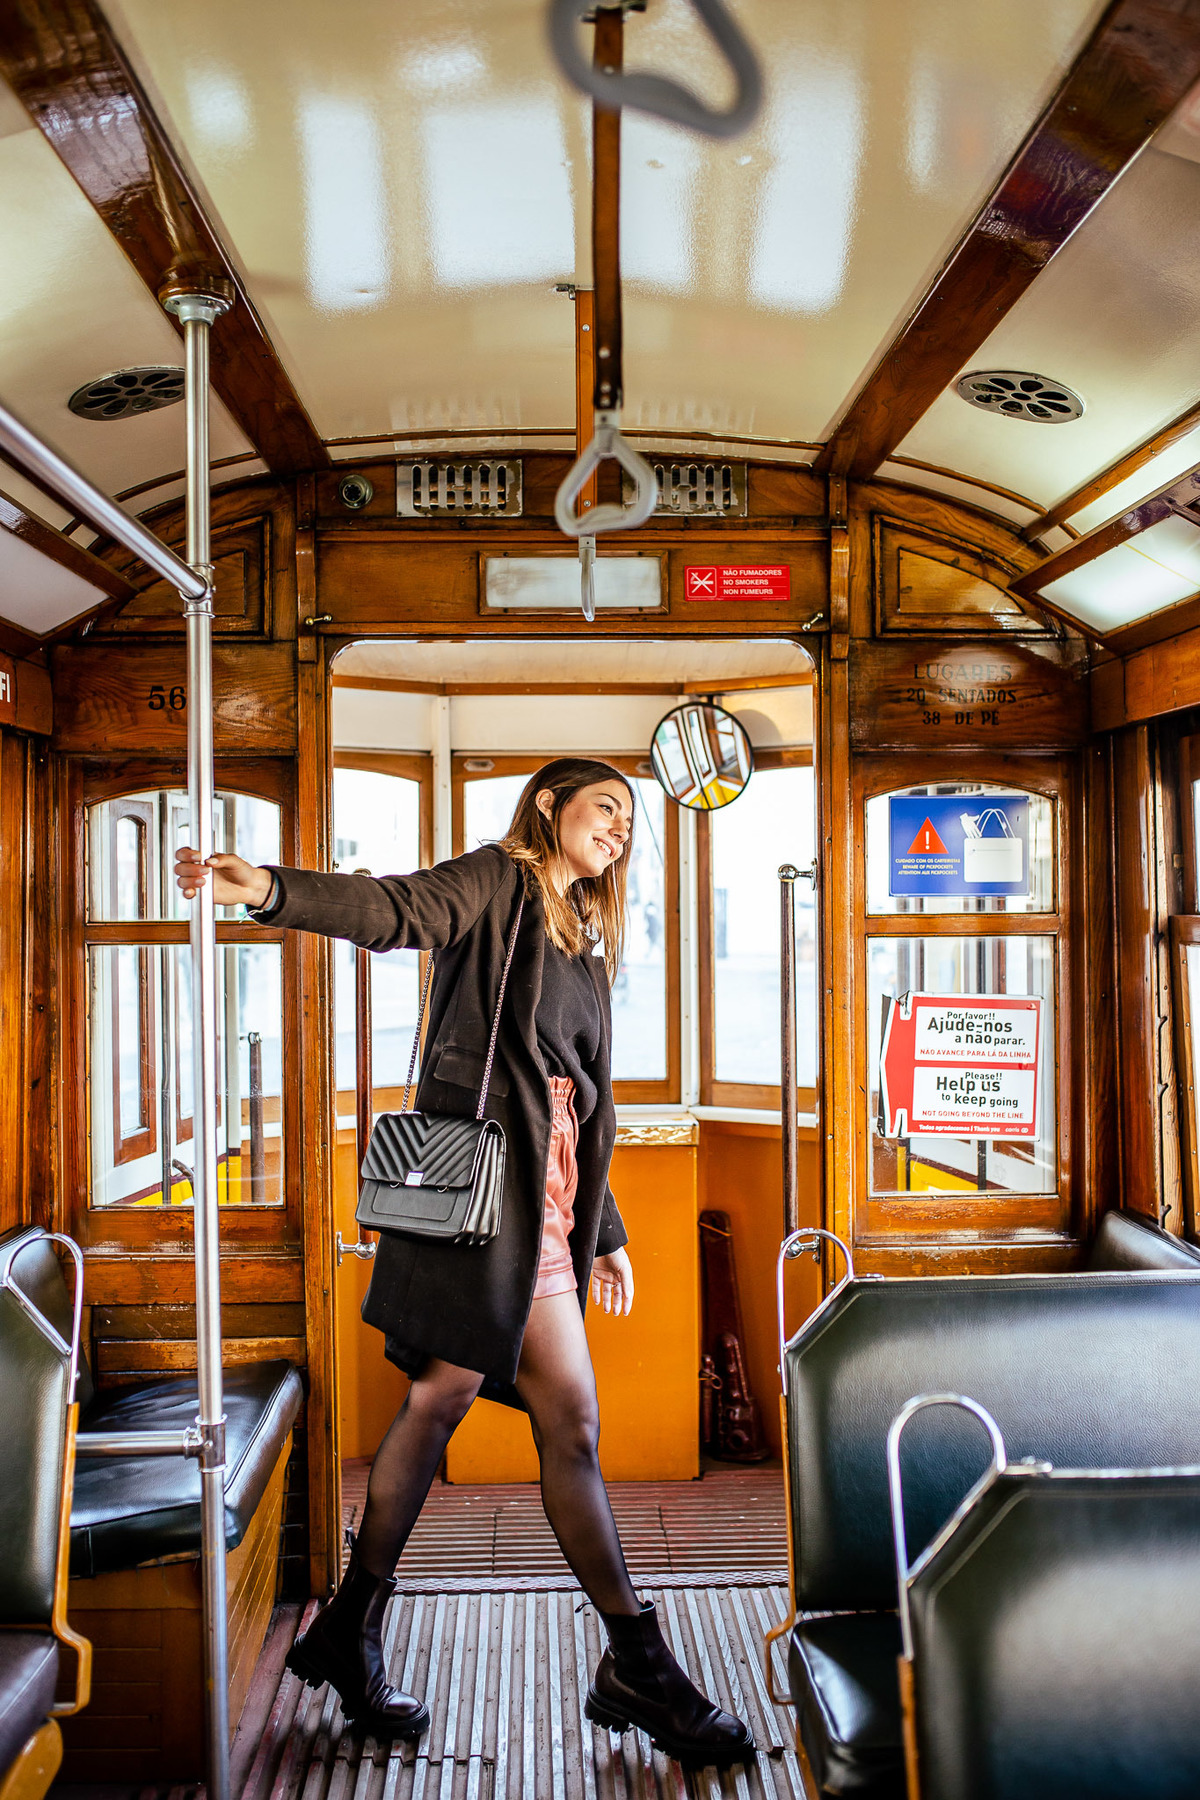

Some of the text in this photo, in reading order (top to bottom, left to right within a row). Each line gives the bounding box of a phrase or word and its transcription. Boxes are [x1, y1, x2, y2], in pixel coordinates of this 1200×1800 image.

[914, 664, 1012, 681] LUGARES
[907, 688, 1016, 703] 20 SENTADOS
[923, 711, 940, 725] 38
[955, 711, 974, 725] DE
[965, 1012, 995, 1020] favor!!
[928, 1017, 1012, 1033] Ajude-nos
[955, 1031, 1026, 1046] a não parar.
[965, 1072, 1002, 1080] Please!!
[936, 1076, 1000, 1094] Help us
[955, 1093, 986, 1107] keep
[990, 1096, 1018, 1108] going
